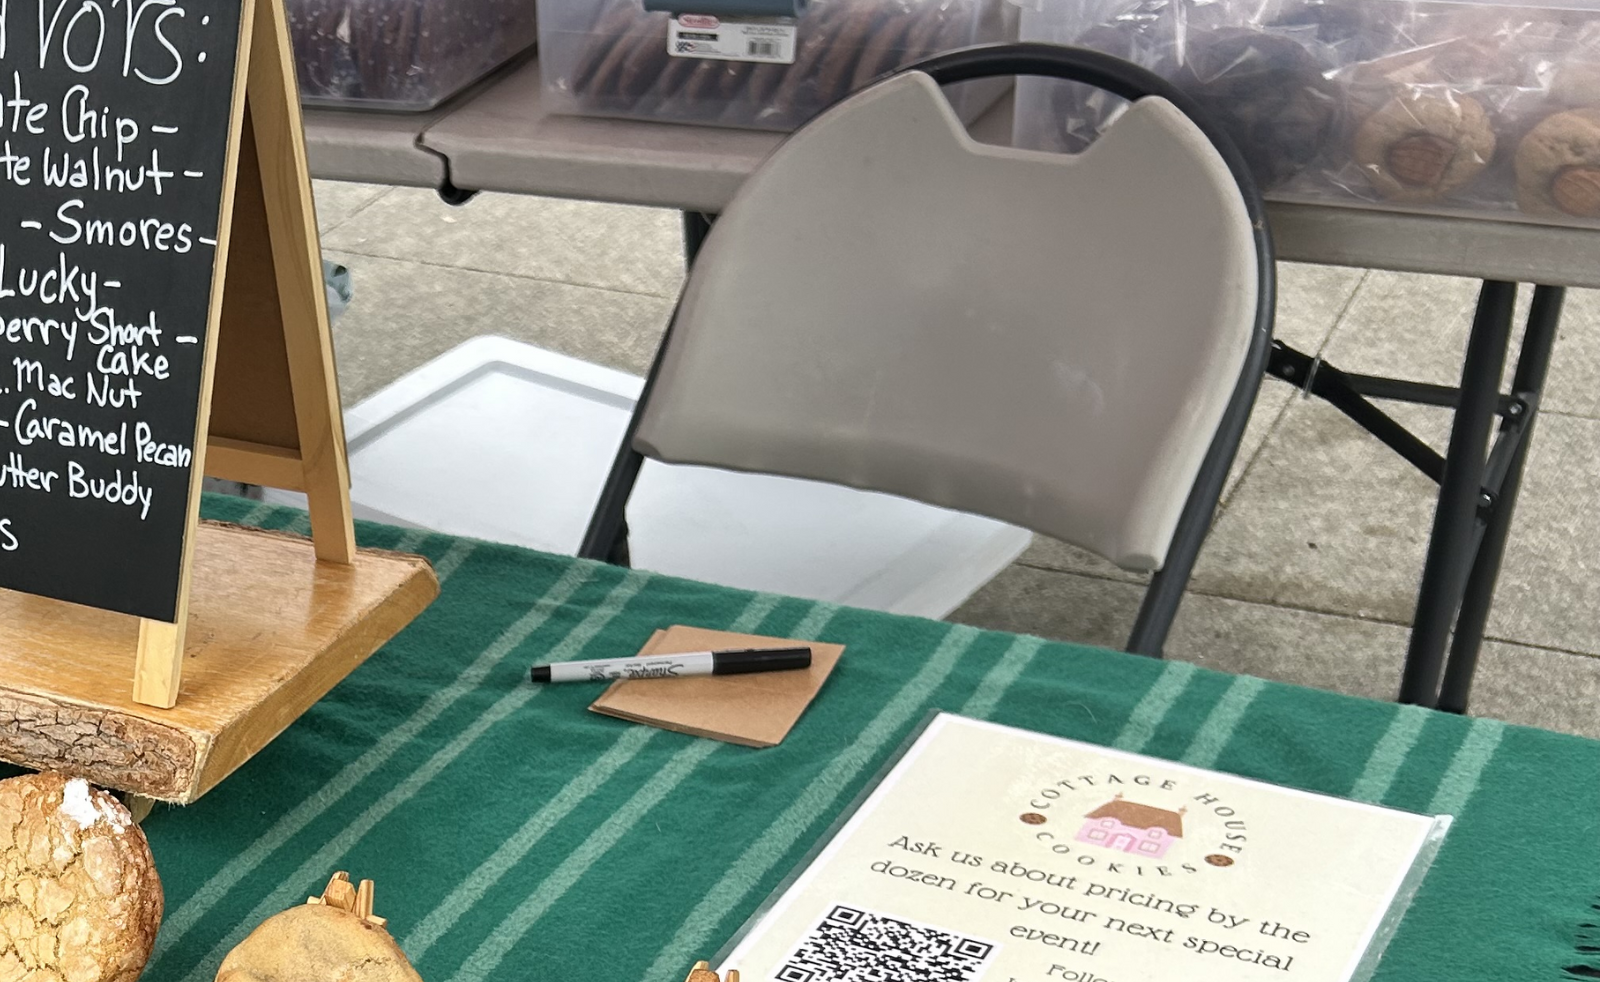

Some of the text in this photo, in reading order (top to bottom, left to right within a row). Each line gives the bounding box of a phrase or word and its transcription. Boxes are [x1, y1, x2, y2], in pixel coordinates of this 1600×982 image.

[13, 357, 76, 400] Mac
[87, 371, 142, 409] Nut
[96, 345, 170, 380] Cake
[135, 422, 192, 468] Pecan
[68, 461, 153, 520] Buddy
[1030, 774, 1247, 853] COTTAGE HOUSE
[1036, 832, 1197, 876] COOKIES
[870, 857, 1295, 972] dozen for your next special
[887, 834, 1313, 945] Ask us about pricing by the
[1009, 921, 1101, 957] event!
